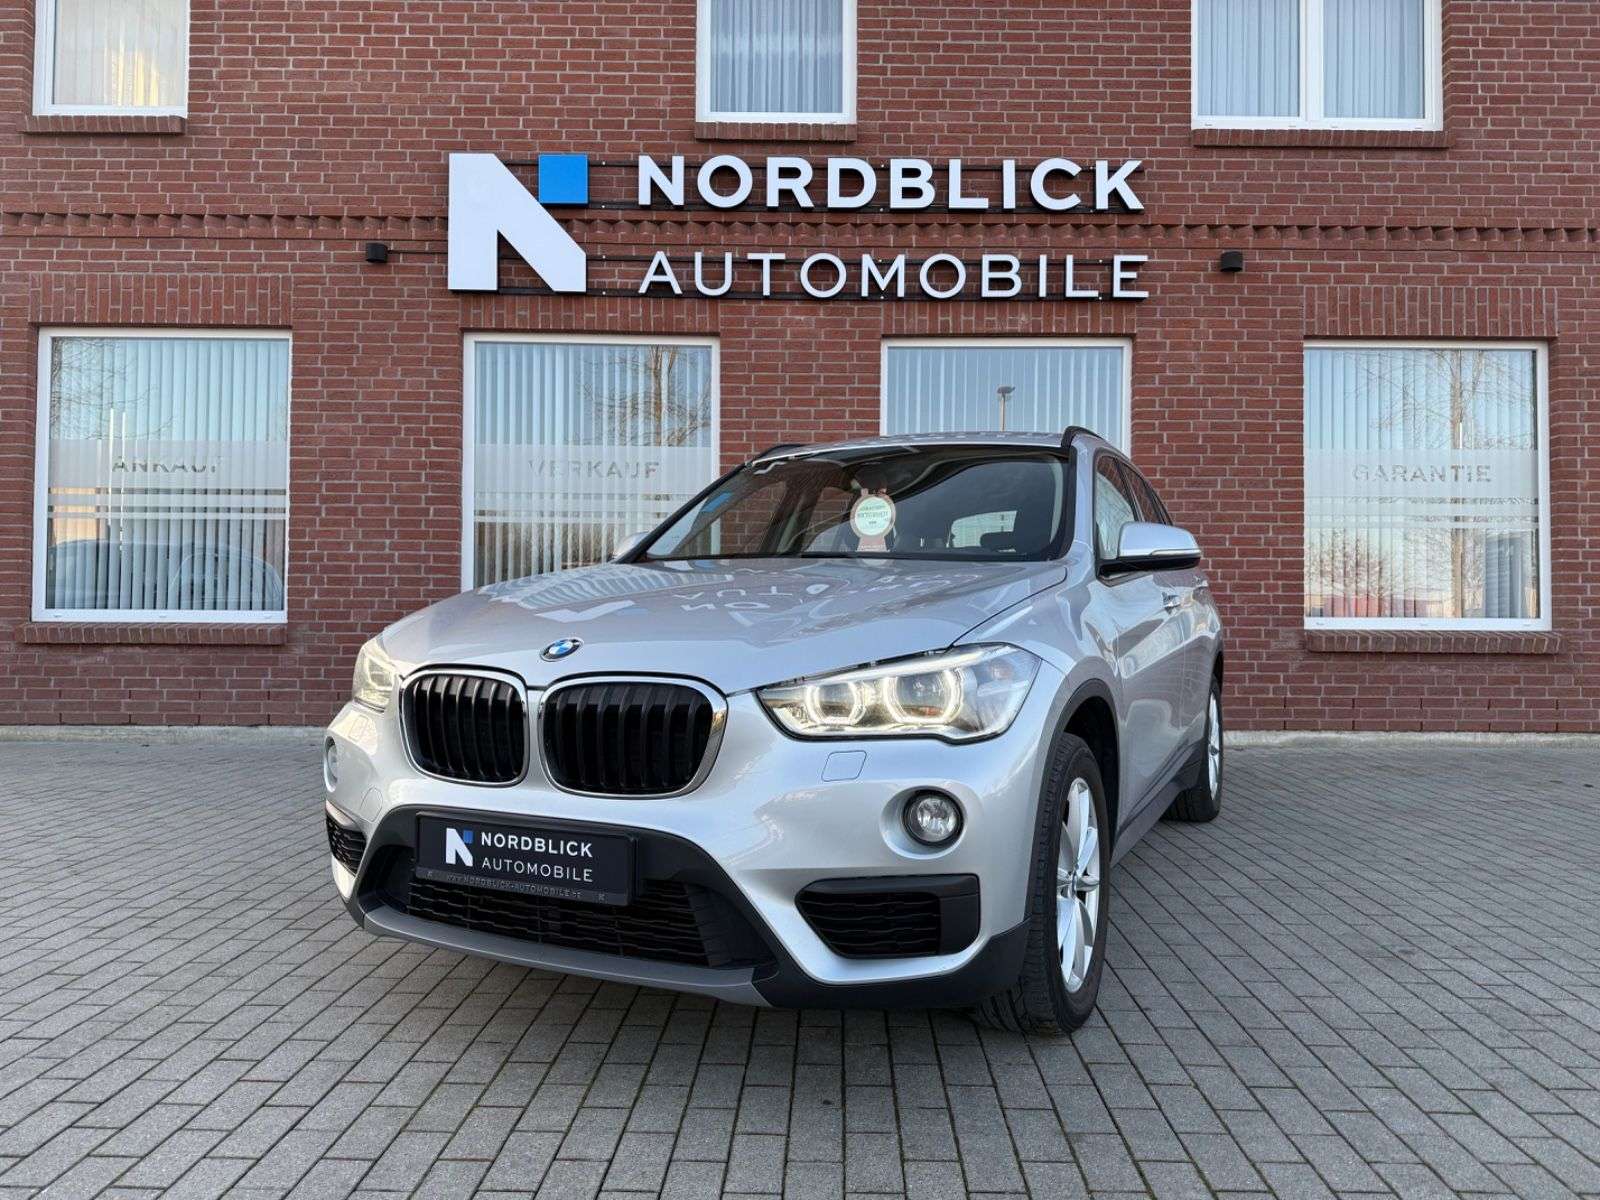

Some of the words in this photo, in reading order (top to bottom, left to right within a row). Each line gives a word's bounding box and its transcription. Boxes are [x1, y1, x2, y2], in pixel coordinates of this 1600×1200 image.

[638, 154, 1146, 212] NORDBLICK
[638, 250, 1150, 300] AUTOMOBILE
[528, 459, 660, 479] VERKAUF
[1353, 464, 1492, 483] GARANTIE
[481, 831, 593, 858] NORDBLICK
[482, 856, 593, 883] AUTOMOBILE
